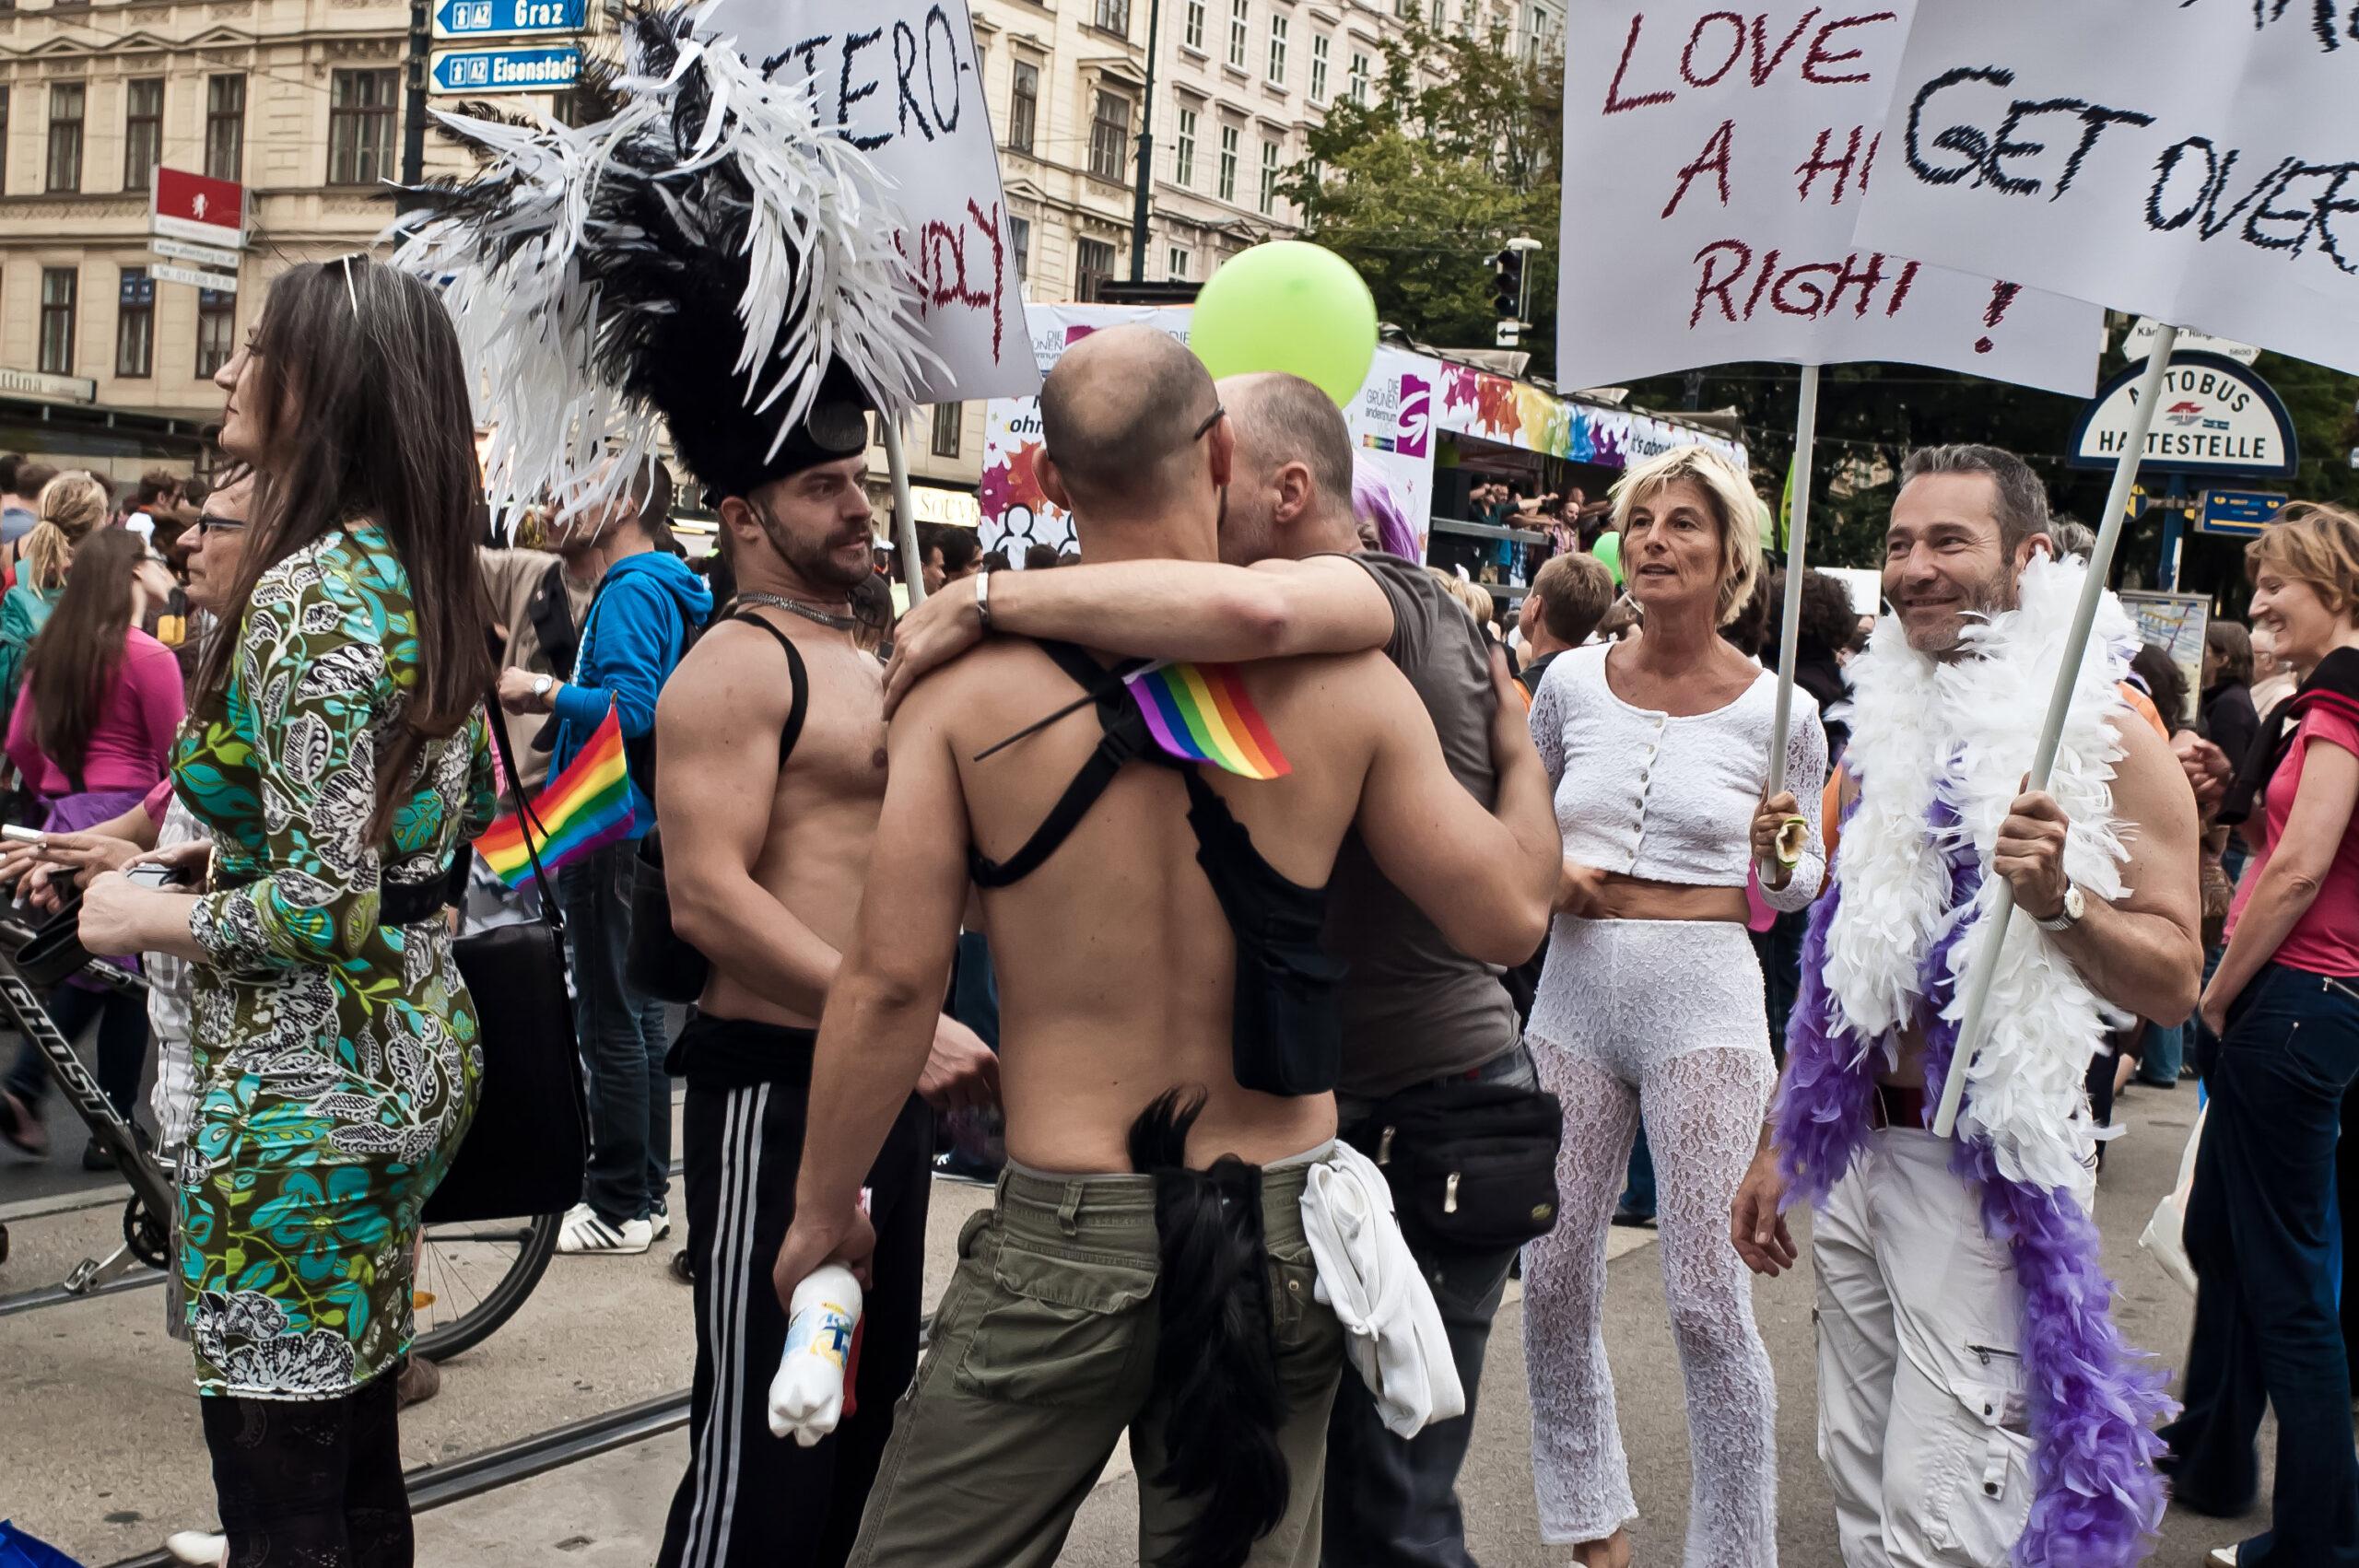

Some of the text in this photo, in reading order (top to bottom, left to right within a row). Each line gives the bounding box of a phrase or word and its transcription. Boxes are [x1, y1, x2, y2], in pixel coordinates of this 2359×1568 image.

[473, 0, 564, 27] A2 Graz
[470, 58, 486, 80] A2
[1602, 6, 1896, 116] LOVE
[1661, 119, 1736, 219] A
[1905, 64, 2359, 275] GET OVER
[1366, 388, 1398, 410] GRÜNEN
[1387, 378, 1400, 395] DIE
[2128, 370, 2249, 413] ATOBUS
[2099, 430, 2266, 459] HATESTELLE
[0, 975, 124, 1127] GHOST
